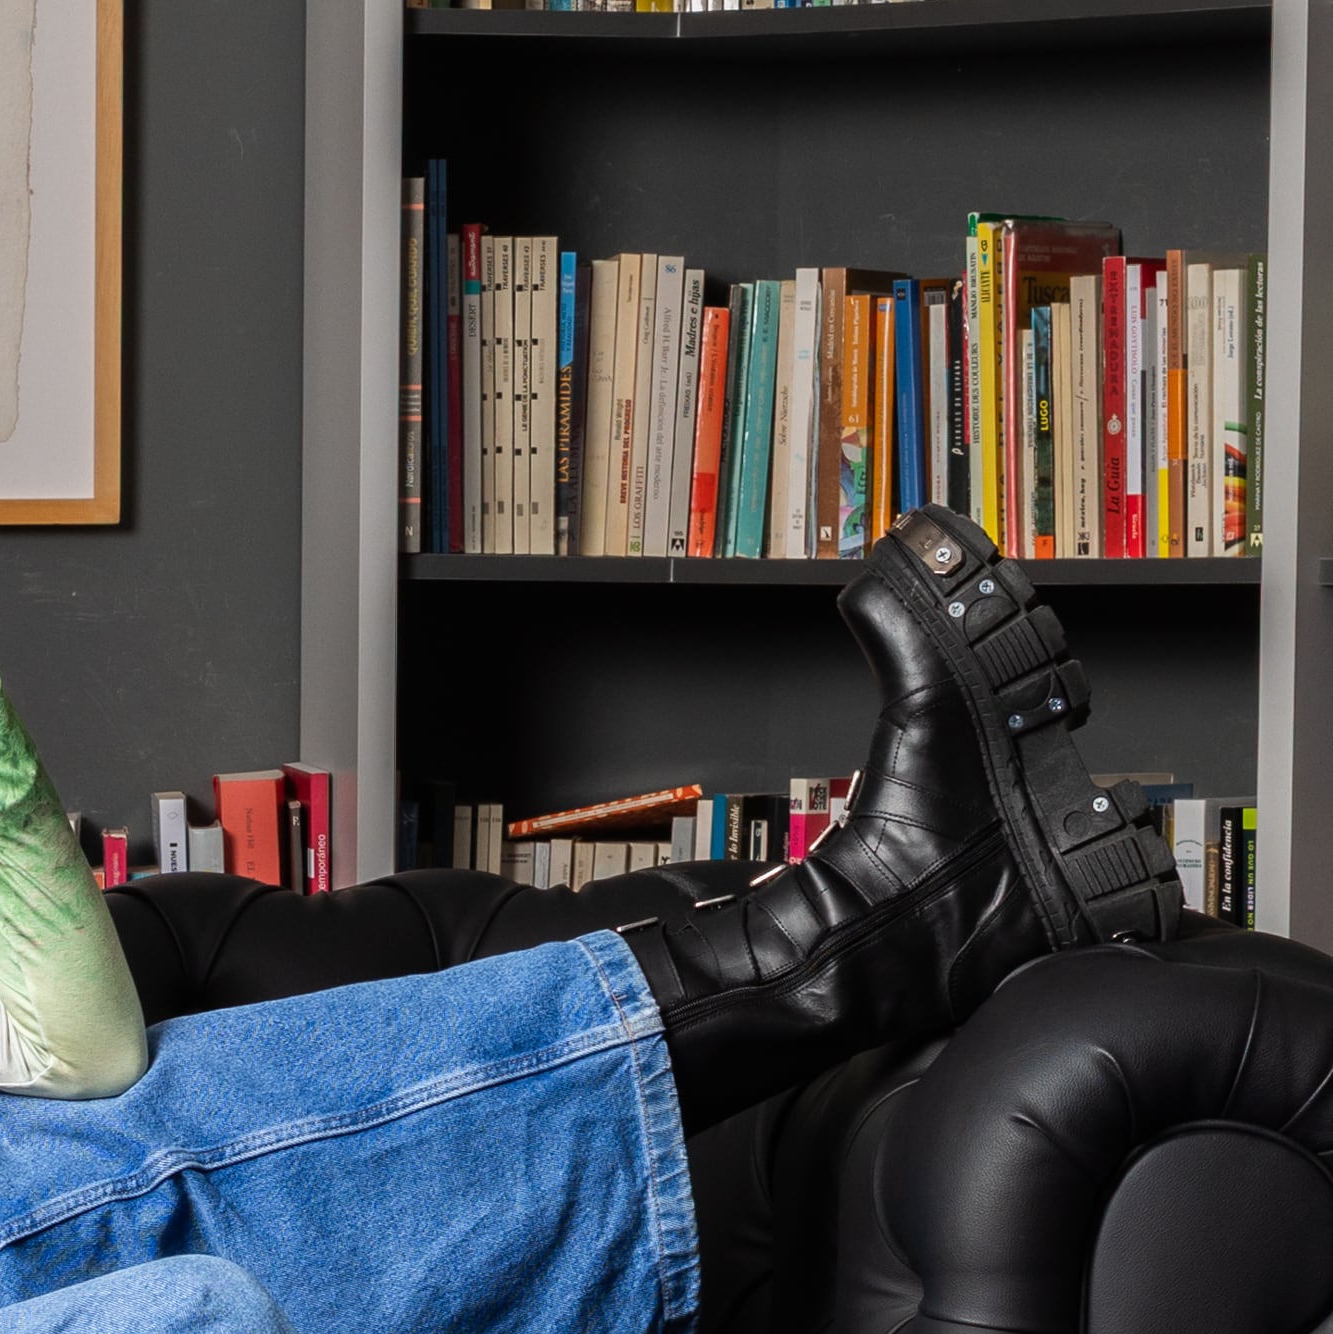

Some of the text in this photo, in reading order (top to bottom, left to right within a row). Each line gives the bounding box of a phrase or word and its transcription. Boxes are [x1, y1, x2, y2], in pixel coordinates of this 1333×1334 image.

[665, 264, 676, 274] 86
[688, 279, 701, 305] hijas
[969, 252, 978, 320] MANLIO BRUSATIN
[980, 270, 990, 303] ALICANTE
[467, 304, 477, 337] DESERT
[662, 307, 672, 332] Alfred
[1253, 261, 1265, 400] La conspiración de las lectoras
[685, 318, 697, 357] Madres
[827, 333, 835, 359] Madrid
[1130, 304, 1138, 375] LUIS GOYTISOLO
[661, 345, 670, 363] Barr
[659, 380, 668, 389] La
[971, 343, 981, 444] HISTOIRE DES COULEURS
[623, 399, 632, 435] PROGRESO
[656, 391, 668, 431] definición
[682, 389, 691, 418] FREIXAS
[1039, 400, 1049, 430] LUGO
[558, 366, 572, 482] LAS PIRAMIDES
[614, 399, 623, 440] Ronald Wright
[848, 414, 860, 424] 61
[1254, 411, 1262, 435] CASTRO
[622, 437, 630, 449] DEL
[656, 433, 666, 444] del
[778, 426, 788, 446] Sobre
[621, 450, 629, 481] HISTORIA
[654, 446, 664, 462] arte
[653, 464, 662, 499] moderno
[1079, 478, 1087, 494] hoy
[1106, 457, 1121, 514] La Guía
[632, 466, 644, 529] LOS GRAFFITI
[1254, 489, 1262, 511] MARINA
[728, 803, 740, 853] lo Invisible
[1247, 840, 1254, 851] LO
[1222, 819, 1234, 912] En la confidencia
[1247, 873, 1254, 885] UN
[1246, 912, 1254, 925] NO
